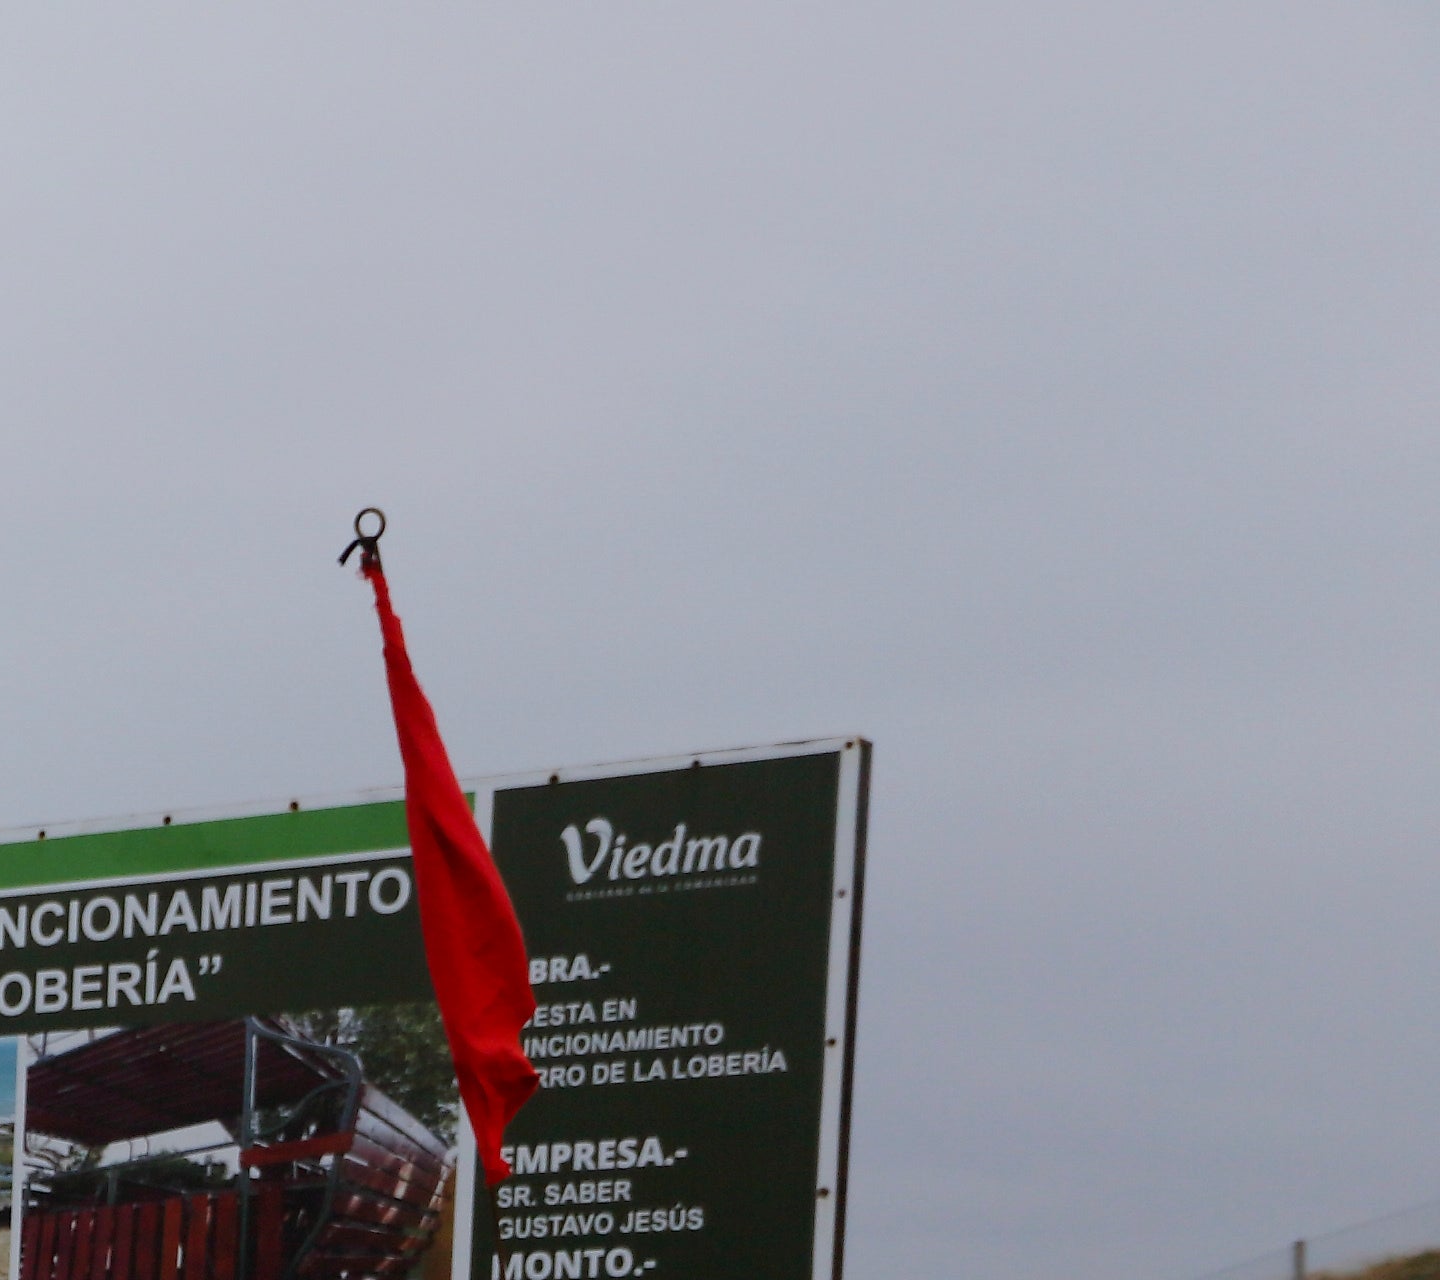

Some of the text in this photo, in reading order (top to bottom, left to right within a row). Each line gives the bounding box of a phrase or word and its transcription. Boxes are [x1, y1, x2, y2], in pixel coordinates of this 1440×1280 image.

[560, 817, 763, 885] Viedma
[528, 952, 611, 986] BRA.-
[523, 998, 638, 1030] ESTA EN
[523, 1022, 725, 1060] NCIONAMIENTO
[537, 1044, 789, 1089] RRO DE LA LOBERÍA
[496, 1180, 632, 1209] SR. SABER
[497, 1202, 705, 1240] GUSTAVO JESÚS
